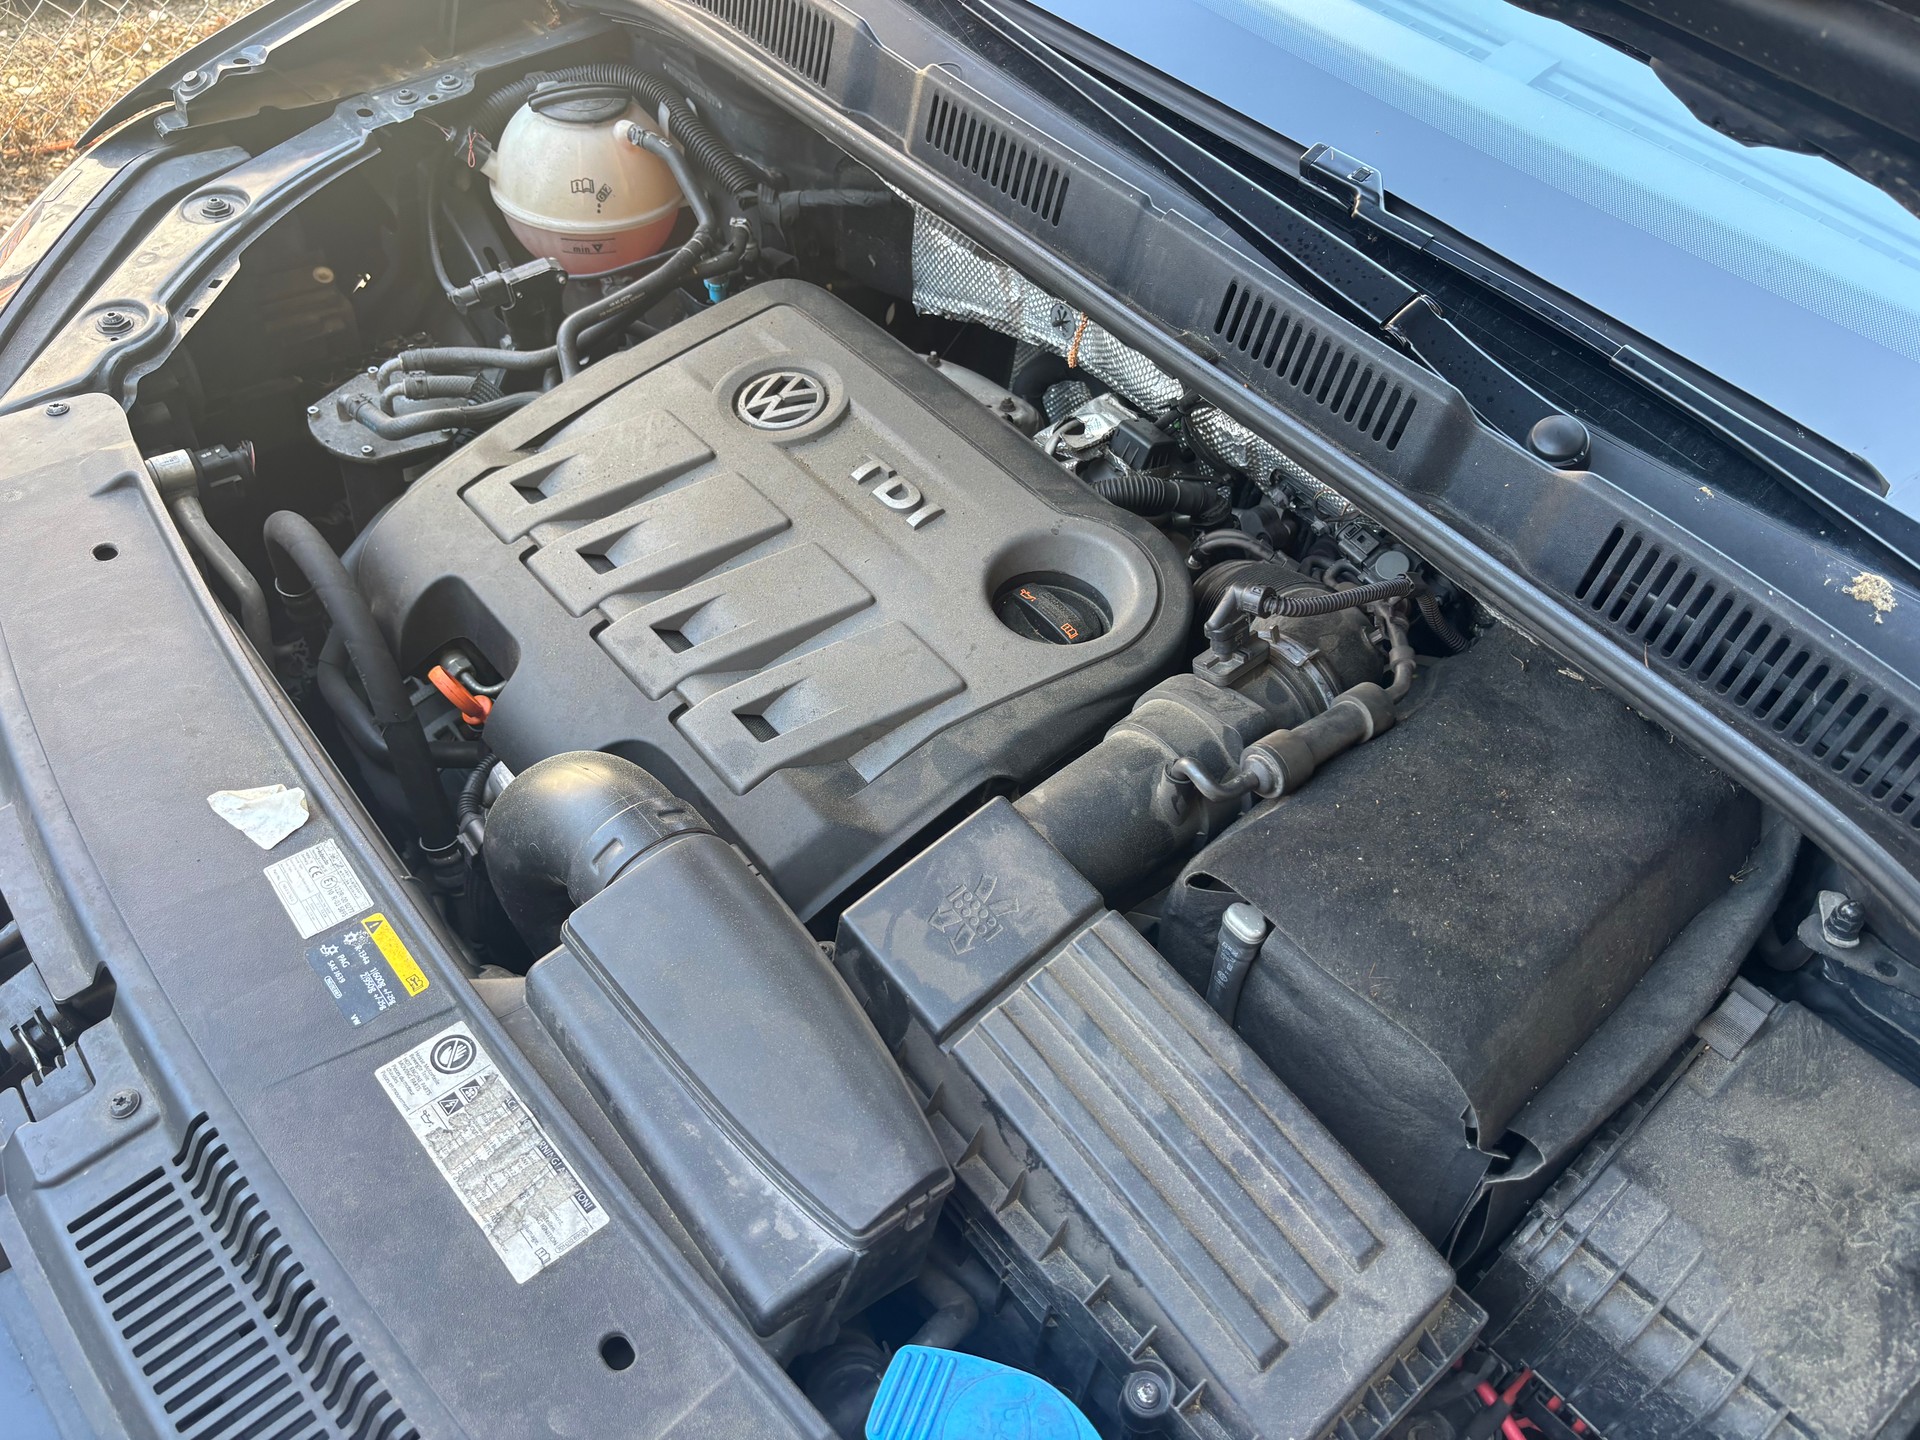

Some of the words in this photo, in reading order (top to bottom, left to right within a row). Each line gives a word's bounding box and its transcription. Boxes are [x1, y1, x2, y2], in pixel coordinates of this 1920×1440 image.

[573, 245, 590, 254] min
[850, 454, 946, 531] TDI
[308, 864, 322, 878] CE
[337, 953, 350, 968] PAG
[355, 944, 371, 964] R-134a
[327, 959, 339, 971] SAE
[350, 1013, 361, 1026] VW
[403, 1056, 411, 1067] HOT
